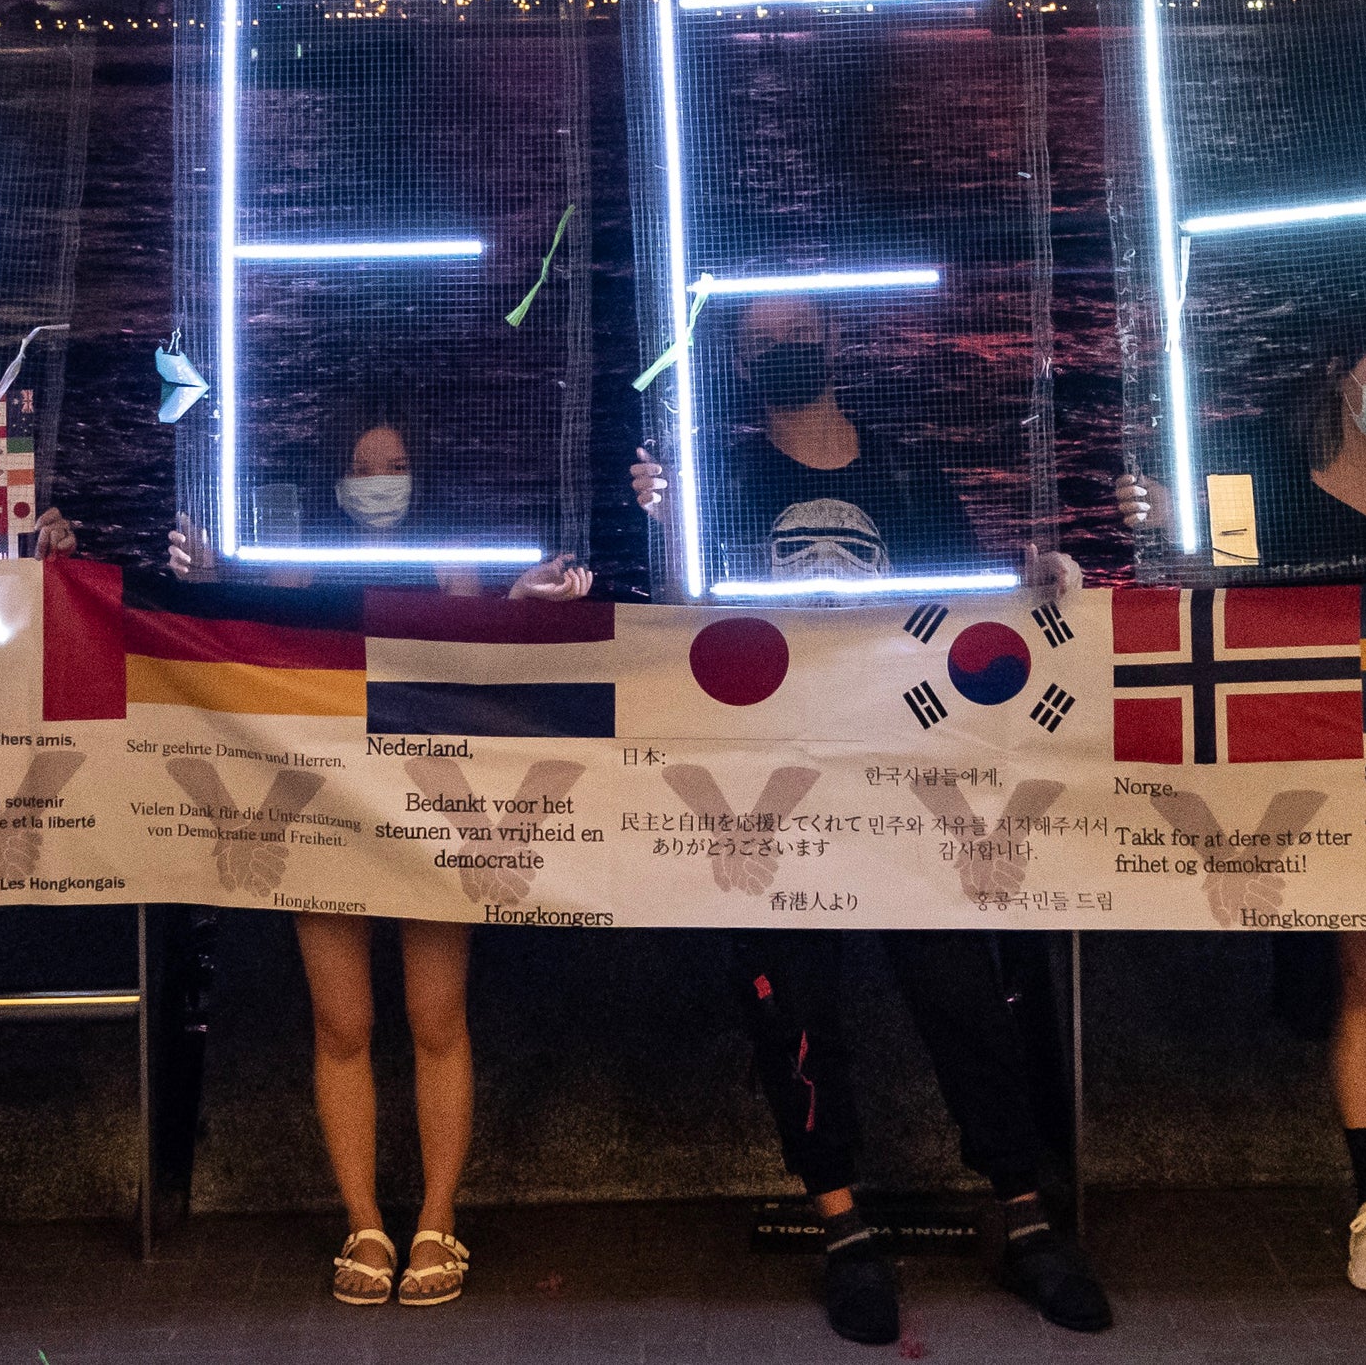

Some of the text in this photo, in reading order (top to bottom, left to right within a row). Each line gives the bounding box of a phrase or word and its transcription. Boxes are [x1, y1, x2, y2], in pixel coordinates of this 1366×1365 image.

[36, 733, 76, 747] amis,
[366, 736, 473, 758] Nederland,
[127, 740, 346, 768] Sehr geehrte Damen und Herren,
[623, 747, 666, 766] 日本:
[1114, 777, 1178, 797] Norge,
[5, 795, 64, 808] soutenir
[405, 792, 574, 814] Bedankt voor het
[12, 817, 27, 828] et
[31, 816, 43, 828] la
[48, 815, 95, 827] liberté
[621, 812, 862, 832] 民主と自由を応援してくれて
[868, 816, 924, 835] 민주와
[932, 816, 989, 835] 자유를
[375, 822, 604, 843] steunen van vrijheid en
[1115, 827, 1166, 846] Takk
[1171, 830, 1198, 846] for
[1204, 831, 1222, 846] at
[1229, 830, 1270, 846] dere
[653, 838, 830, 856] ありがとうございます
[939, 841, 1038, 861] 감사합니다.
[434, 849, 544, 869] democratie
[1115, 854, 1307, 875] frihet og demokrati!
[0, 876, 125, 892] Les Hongkongais
[273, 893, 366, 913] Hongkongers
[769, 892, 858, 911] 香港人より
[1076, 892, 1112, 911] 드림
[484, 905, 613, 926] Hongkongers
